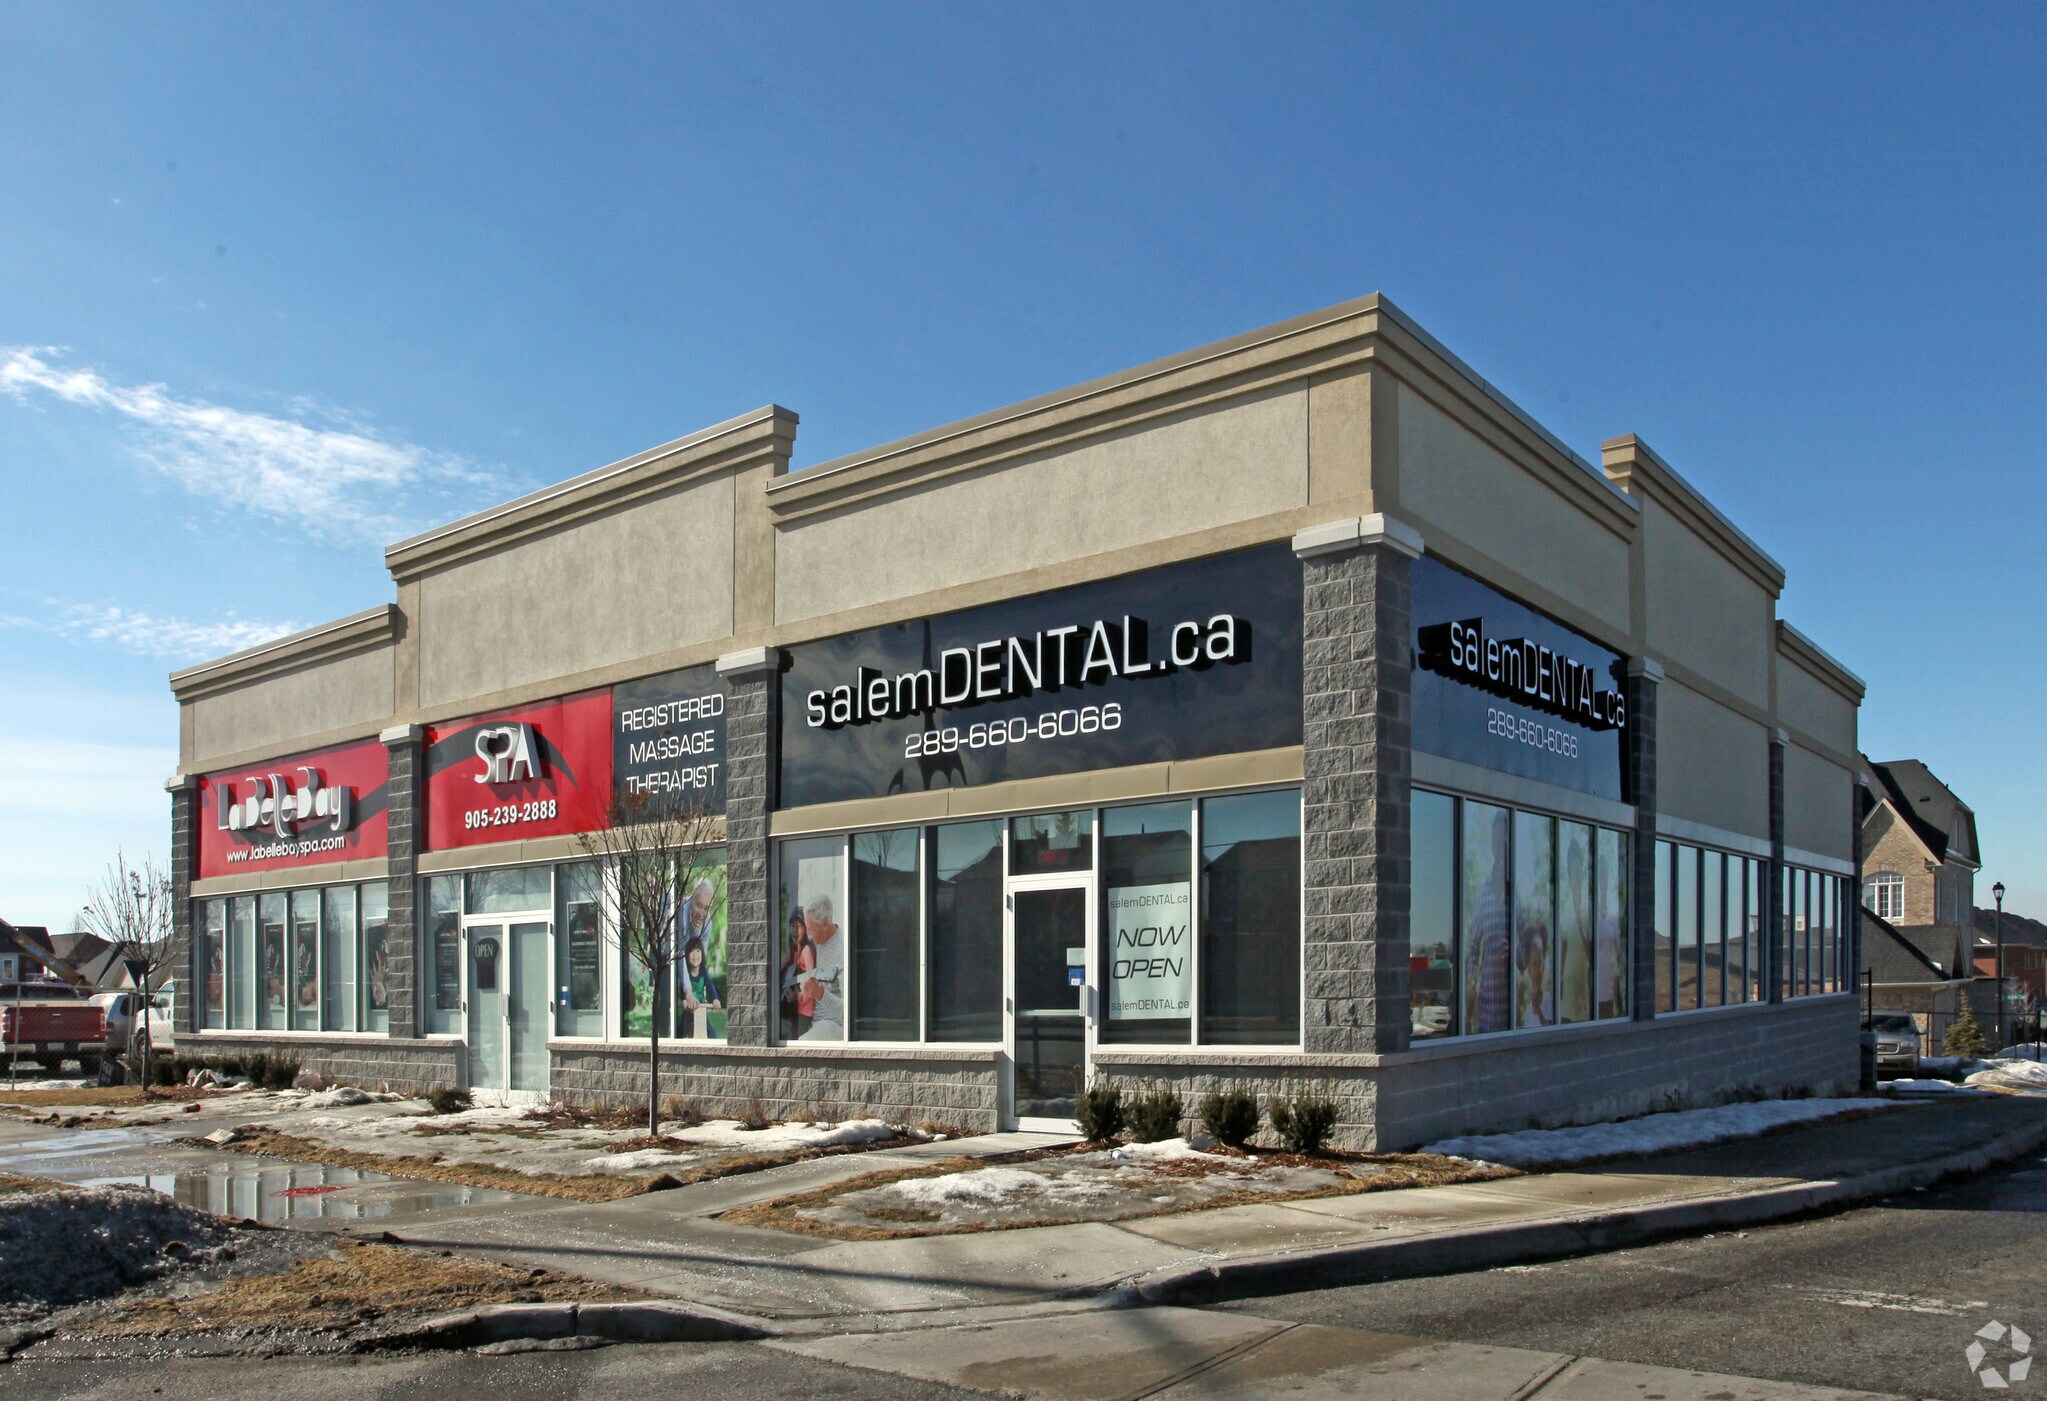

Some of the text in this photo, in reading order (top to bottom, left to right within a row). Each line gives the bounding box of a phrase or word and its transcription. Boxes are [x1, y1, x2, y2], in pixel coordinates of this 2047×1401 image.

[806, 613, 1236, 728] salemDENTAL.ca
[621, 693, 724, 733] REGISTERED
[904, 702, 1123, 759] 289-660-6066
[1487, 707, 1578, 759] 289-660-6066
[473, 721, 543, 784] SPA
[629, 729, 715, 765] MASSAGE
[626, 763, 719, 795] THERAPIST
[464, 799, 557, 830] 905-239-2888
[226, 836, 346, 863] www.labellebayspa.com
[1110, 894, 1188, 909] salemDENTAL.ca
[474, 943, 494, 958] OPEN
[1116, 924, 1187, 949] NOW
[1112, 957, 1184, 980] OPEN
[1111, 999, 1190, 1011] salemDENTAL.ca
